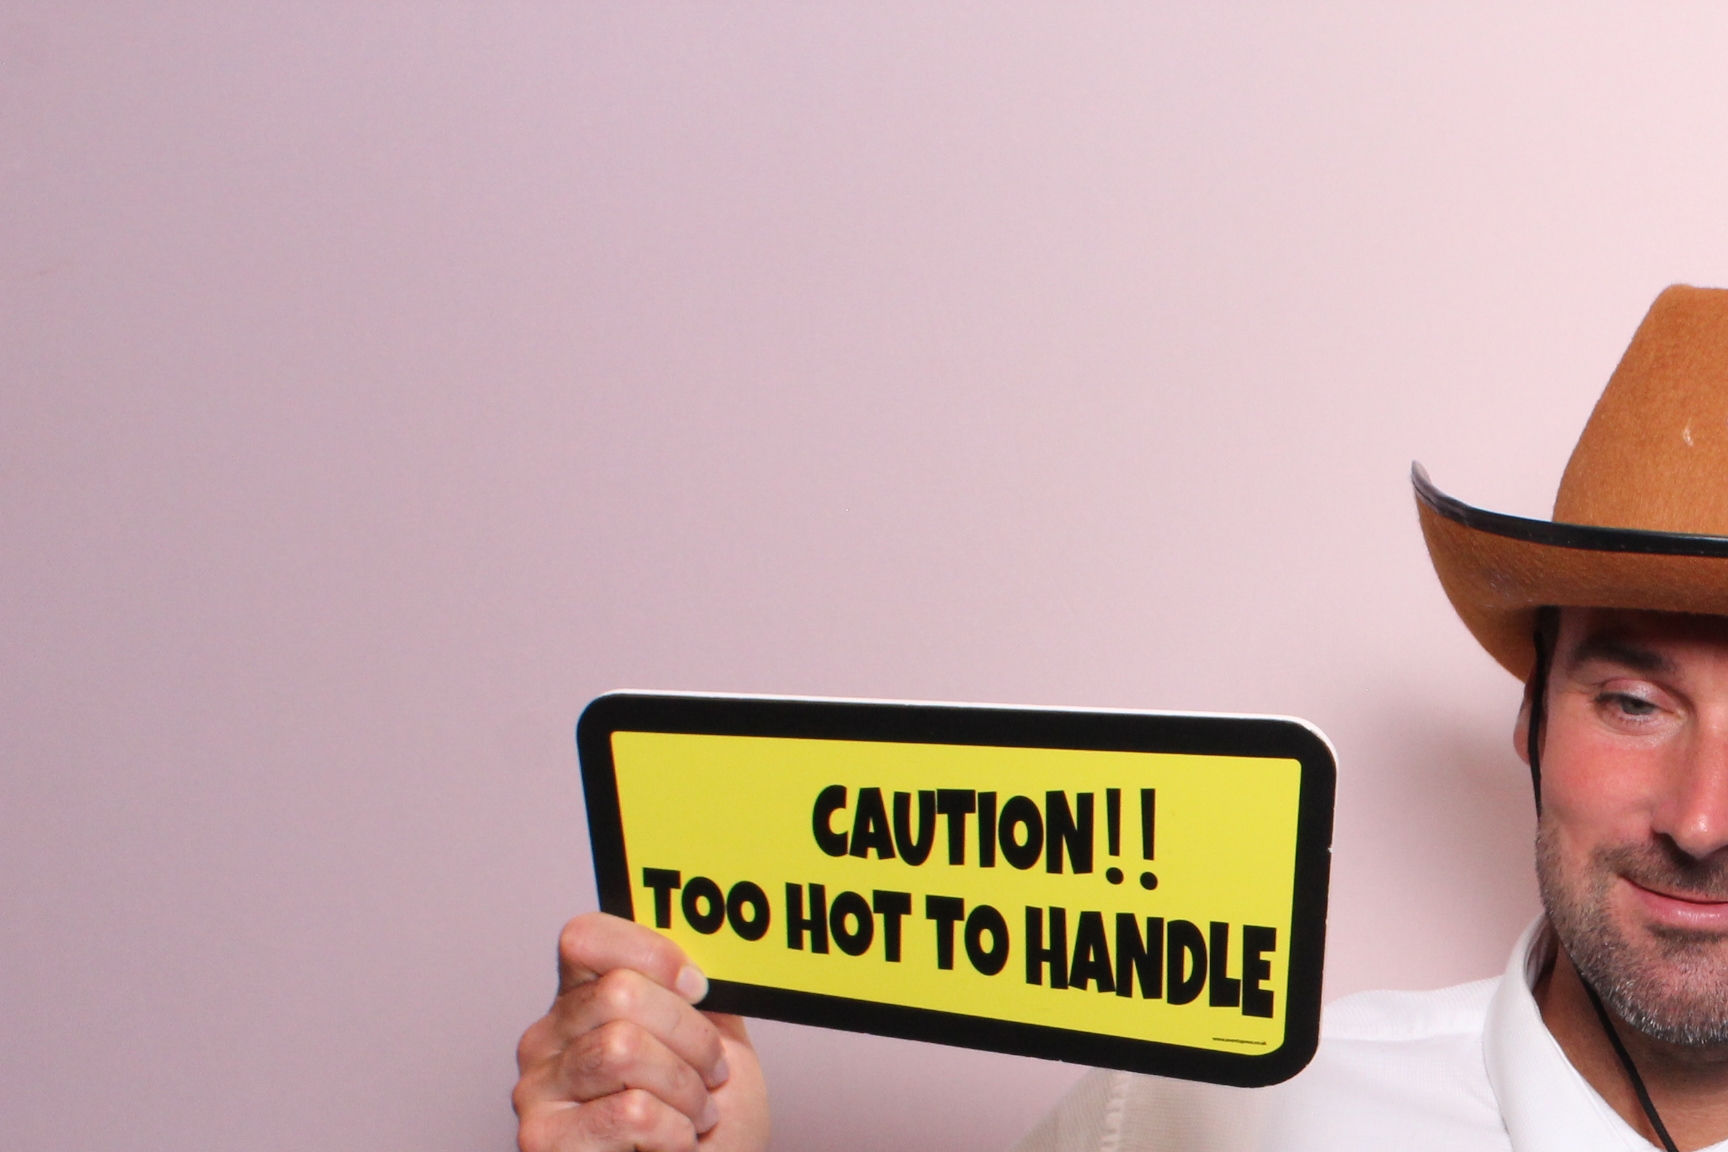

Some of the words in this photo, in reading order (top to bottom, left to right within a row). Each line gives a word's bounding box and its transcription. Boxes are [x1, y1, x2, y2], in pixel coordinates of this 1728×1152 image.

[811, 784, 1159, 891] CAUTION!!
[642, 867, 771, 942] TOO
[785, 882, 912, 963] HOT
[925, 894, 1010, 977] TO
[1025, 905, 1277, 1019] HANDLE
